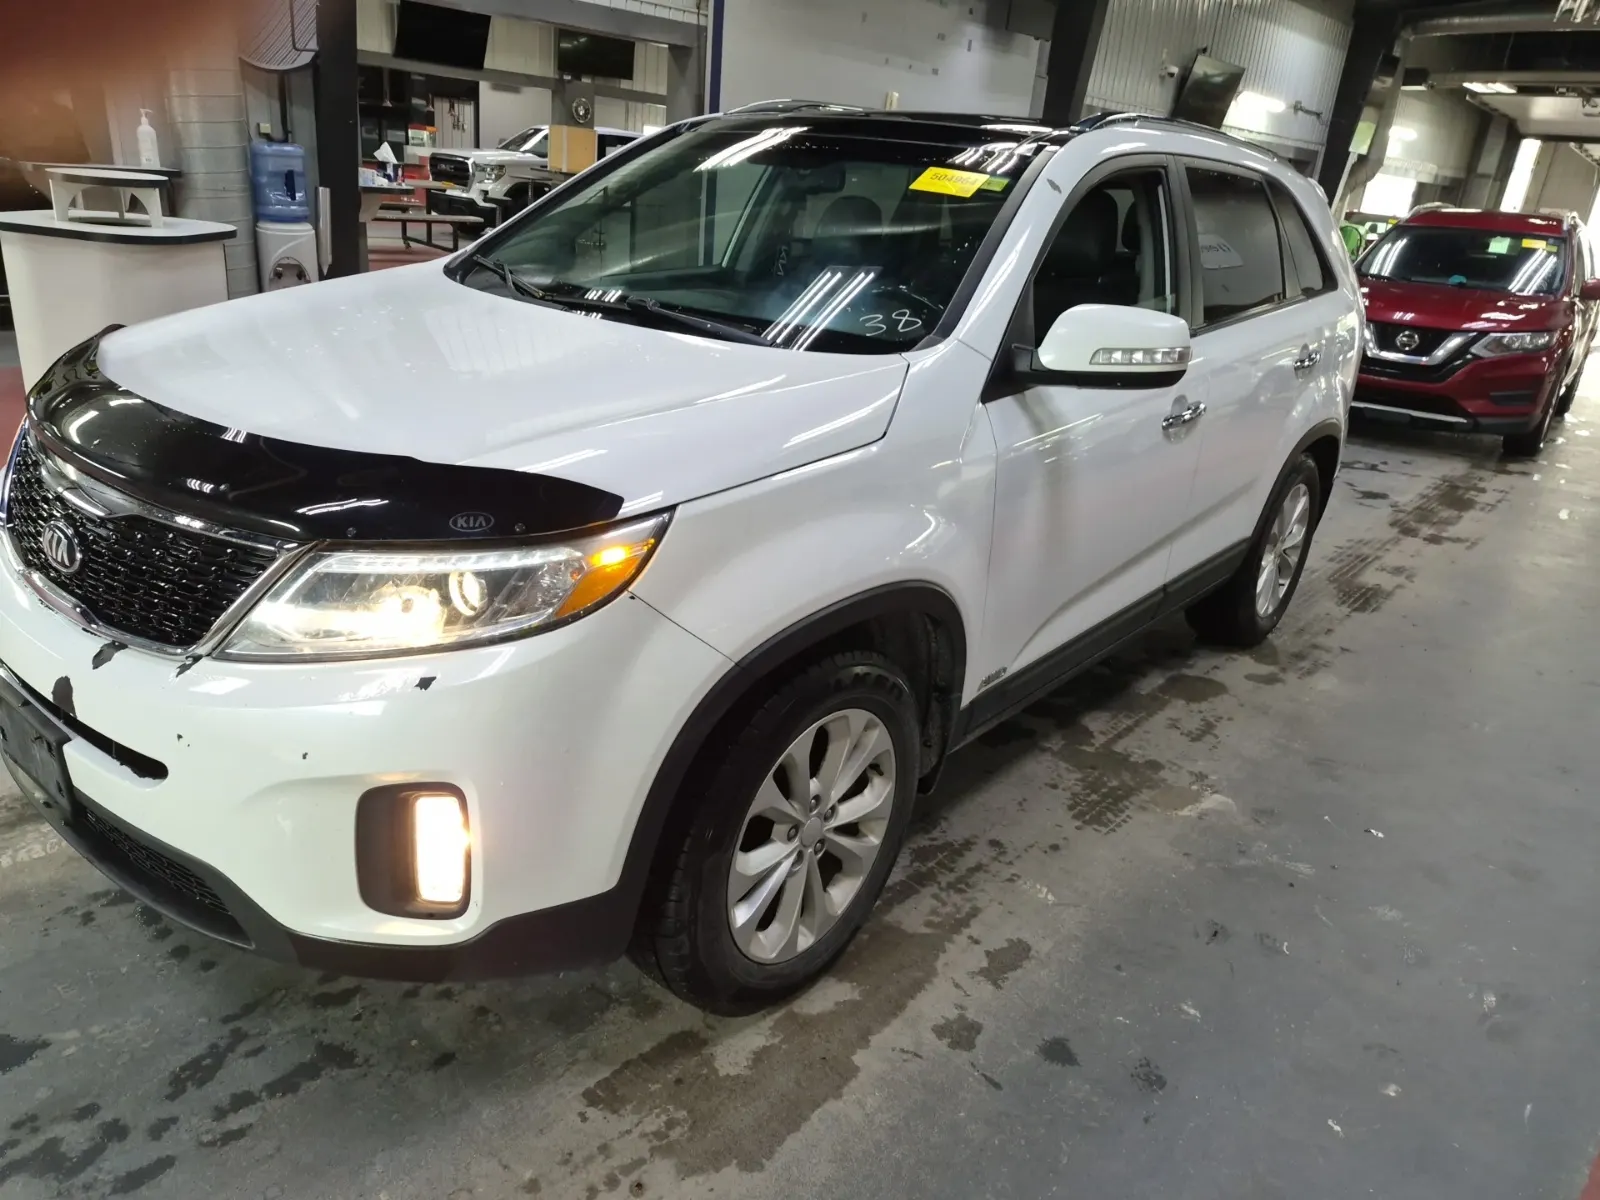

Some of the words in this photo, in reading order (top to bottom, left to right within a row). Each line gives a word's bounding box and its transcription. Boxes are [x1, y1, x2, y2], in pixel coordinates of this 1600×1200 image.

[859, 308, 922, 337] 38
[457, 515, 486, 528] KIA
[43, 527, 70, 567] KIA
